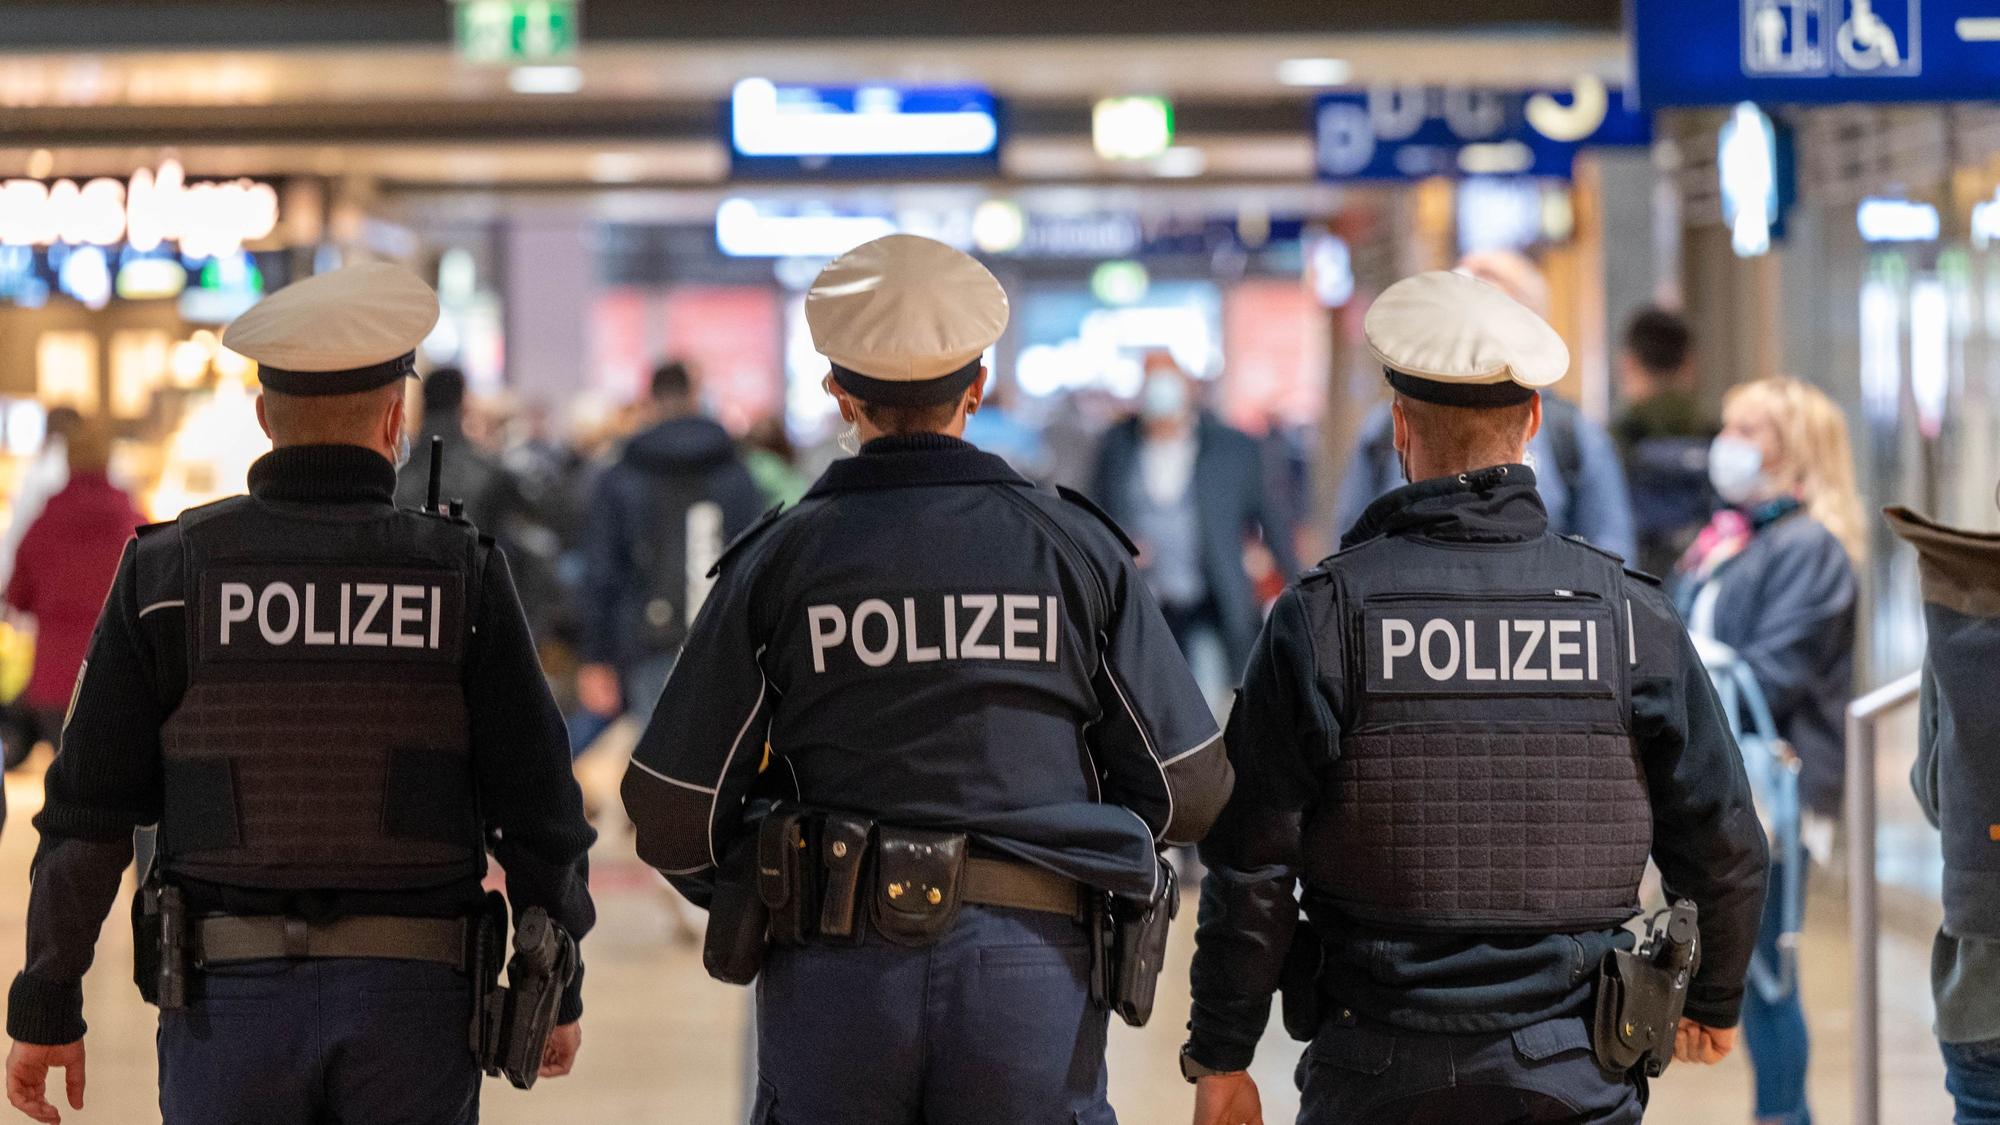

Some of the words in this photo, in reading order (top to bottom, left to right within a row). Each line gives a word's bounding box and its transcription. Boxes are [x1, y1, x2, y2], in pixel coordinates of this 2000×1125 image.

[220, 581, 441, 649] POLIZEI
[807, 594, 1058, 673] POLIZEI
[1381, 617, 1599, 682] POLIZEI
